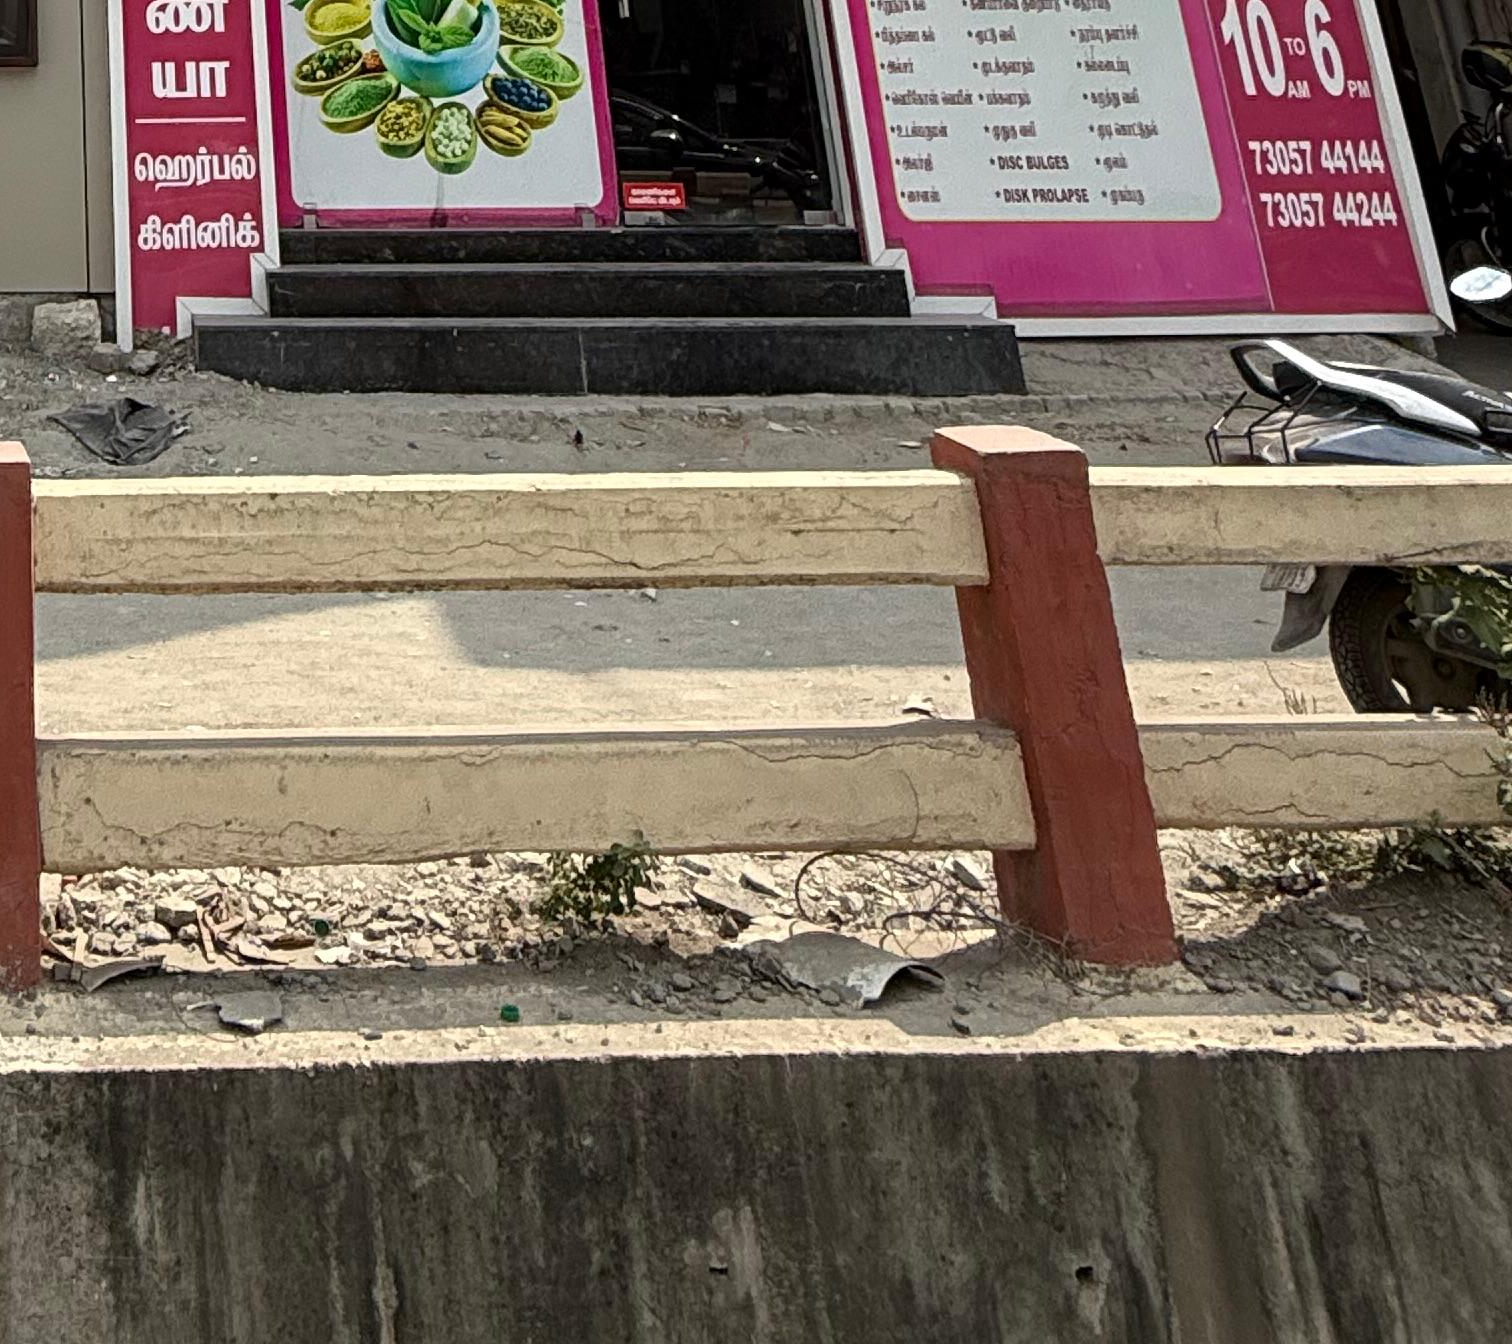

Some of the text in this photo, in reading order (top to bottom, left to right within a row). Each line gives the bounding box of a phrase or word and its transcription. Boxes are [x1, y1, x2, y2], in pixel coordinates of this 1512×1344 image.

[1283, 37, 1306, 56] TO
[1288, 80, 1372, 98] AM PM
[1248, 140, 1385, 175] 73057 44144
[1260, 191, 1398, 228] 73057 44244
